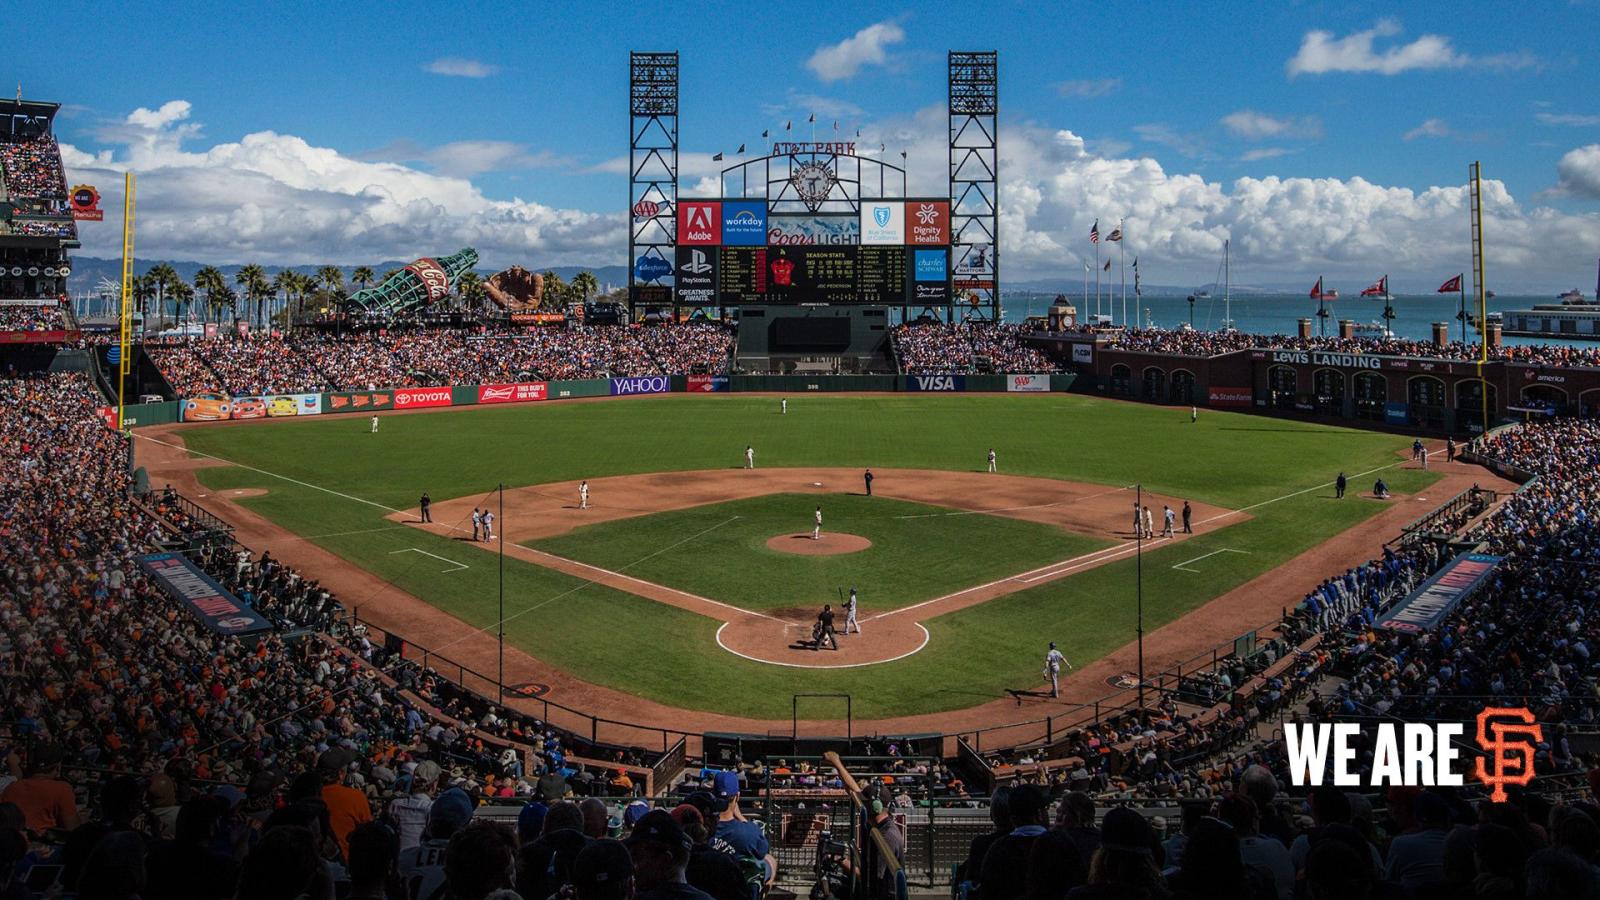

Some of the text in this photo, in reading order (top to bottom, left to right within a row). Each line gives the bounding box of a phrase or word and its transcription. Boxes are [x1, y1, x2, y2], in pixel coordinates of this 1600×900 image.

[773, 143, 855, 156] AT&T PARK
[726, 218, 763, 226] workday
[688, 232, 712, 241] Adobe
[768, 228, 860, 245] Coors LIGHT
[913, 226, 941, 235] Dignity
[1313, 354, 1381, 369] LANDING
[614, 376, 668, 394] YAHOO!
[915, 376, 955, 390] VISA
[411, 392, 451, 402] TOYOTA
